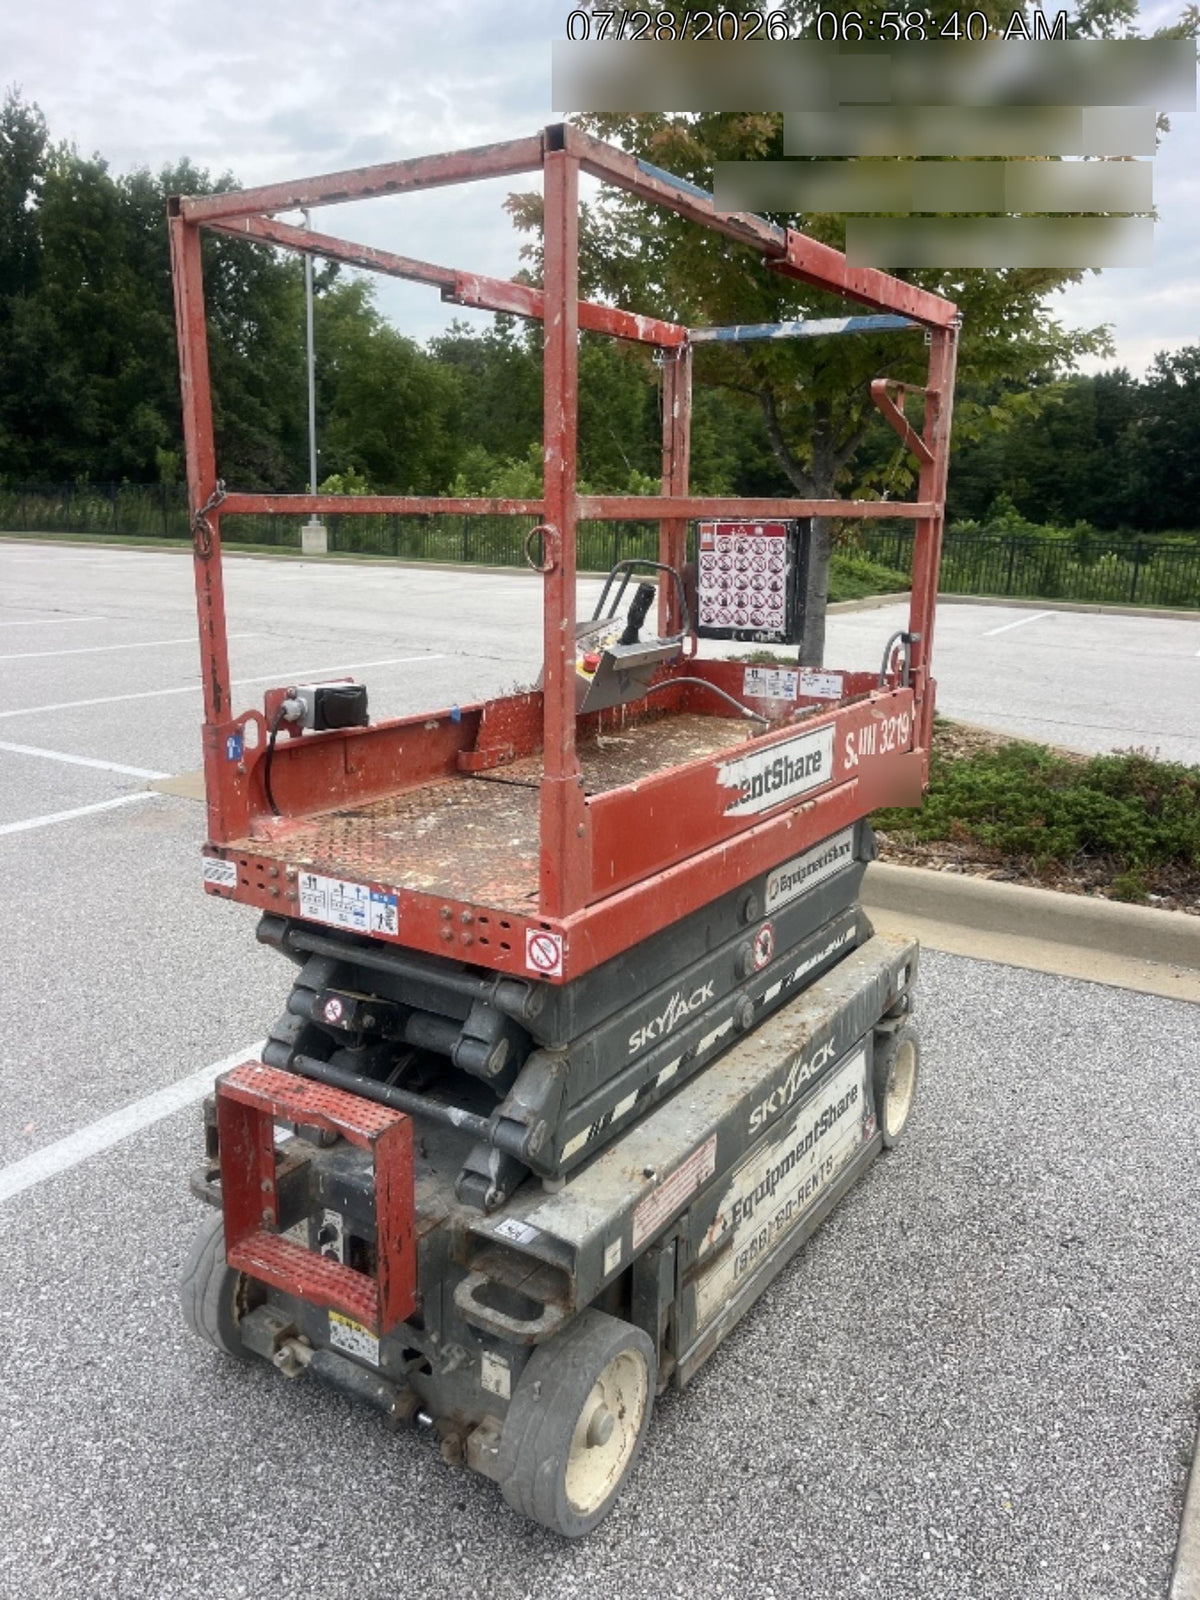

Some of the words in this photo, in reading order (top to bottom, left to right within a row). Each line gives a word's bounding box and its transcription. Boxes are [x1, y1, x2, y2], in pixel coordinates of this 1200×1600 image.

[880, 711, 910, 754] 3219
[628, 979, 715, 1054] SKYJACK
[748, 1036, 836, 1134] SKYJACK
[732, 1083, 858, 1226] EquipmentShare
